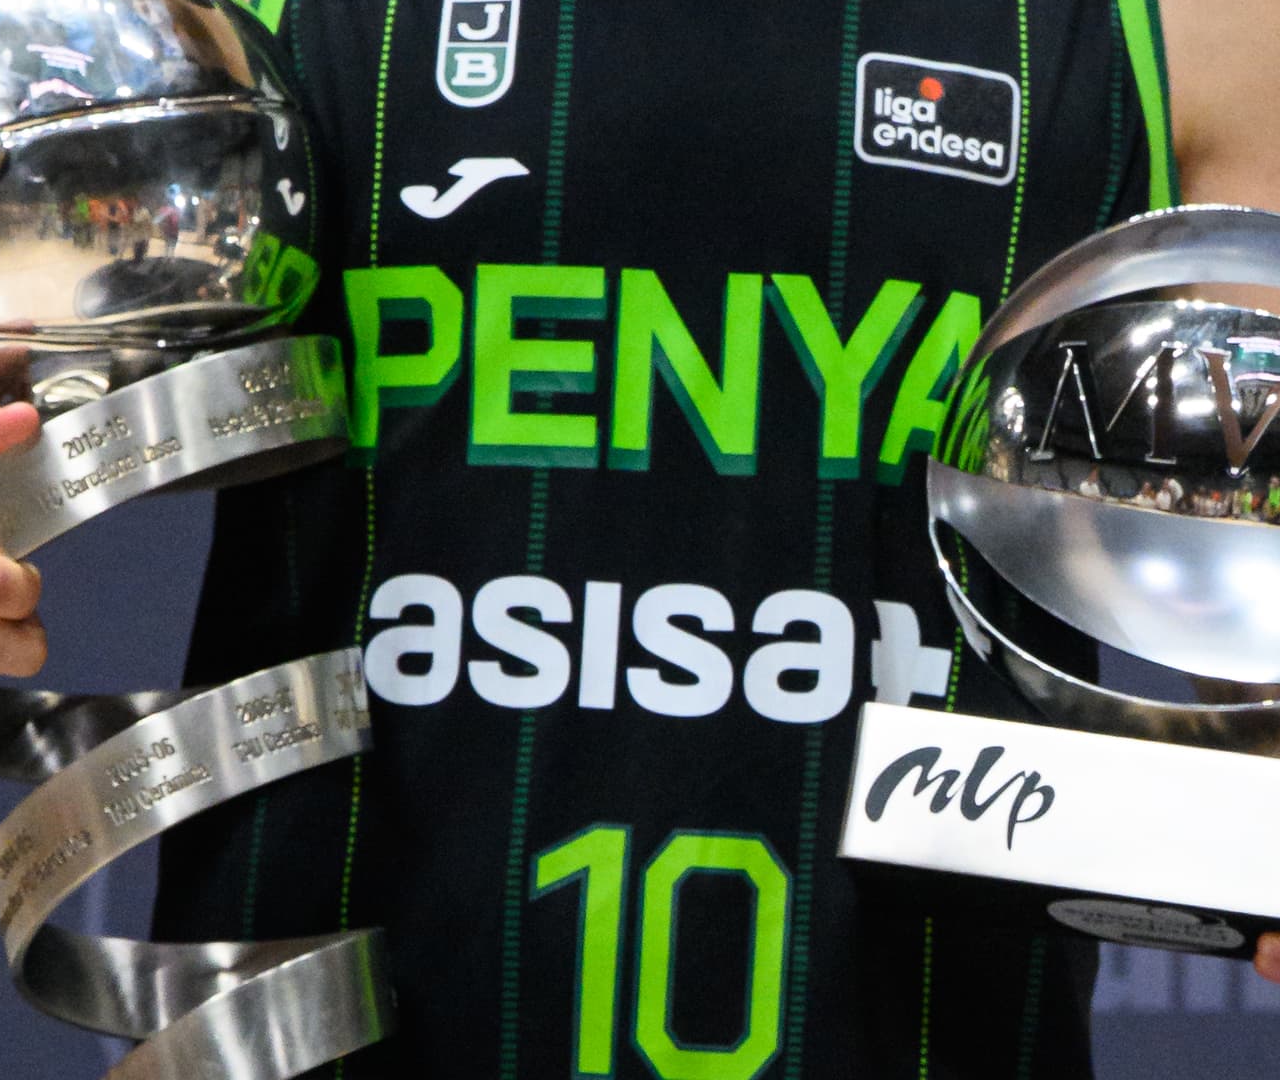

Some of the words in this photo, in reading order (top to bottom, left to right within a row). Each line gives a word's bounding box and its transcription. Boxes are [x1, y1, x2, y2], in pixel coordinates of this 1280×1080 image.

[874, 86, 936, 126] liga
[872, 122, 1004, 168] endesa
[528, 821, 792, 1080] 10
